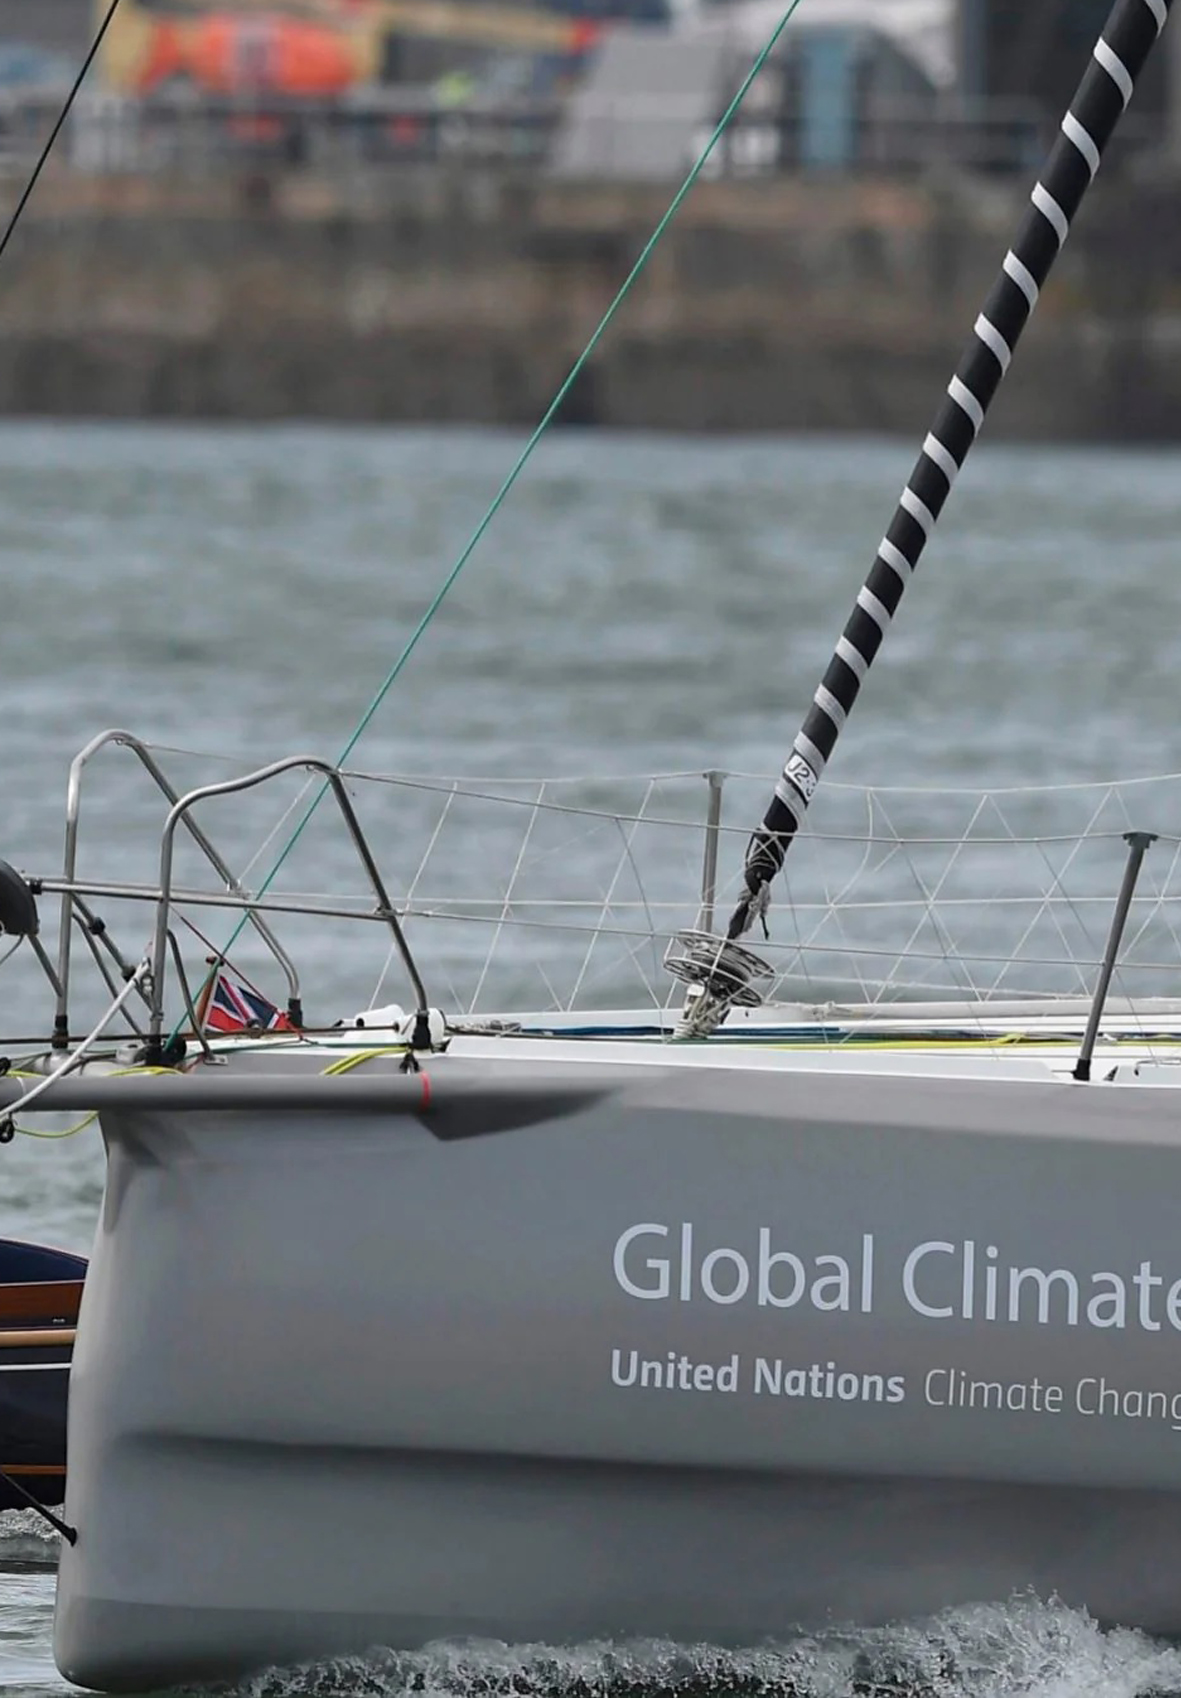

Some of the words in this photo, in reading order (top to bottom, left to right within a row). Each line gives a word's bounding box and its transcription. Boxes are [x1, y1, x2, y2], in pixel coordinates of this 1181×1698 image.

[613, 1222, 874, 1313] Global
[611, 1349, 740, 1393] United
[753, 1358, 905, 1403] Nations
[924, 1368, 1064, 1413] Climate
